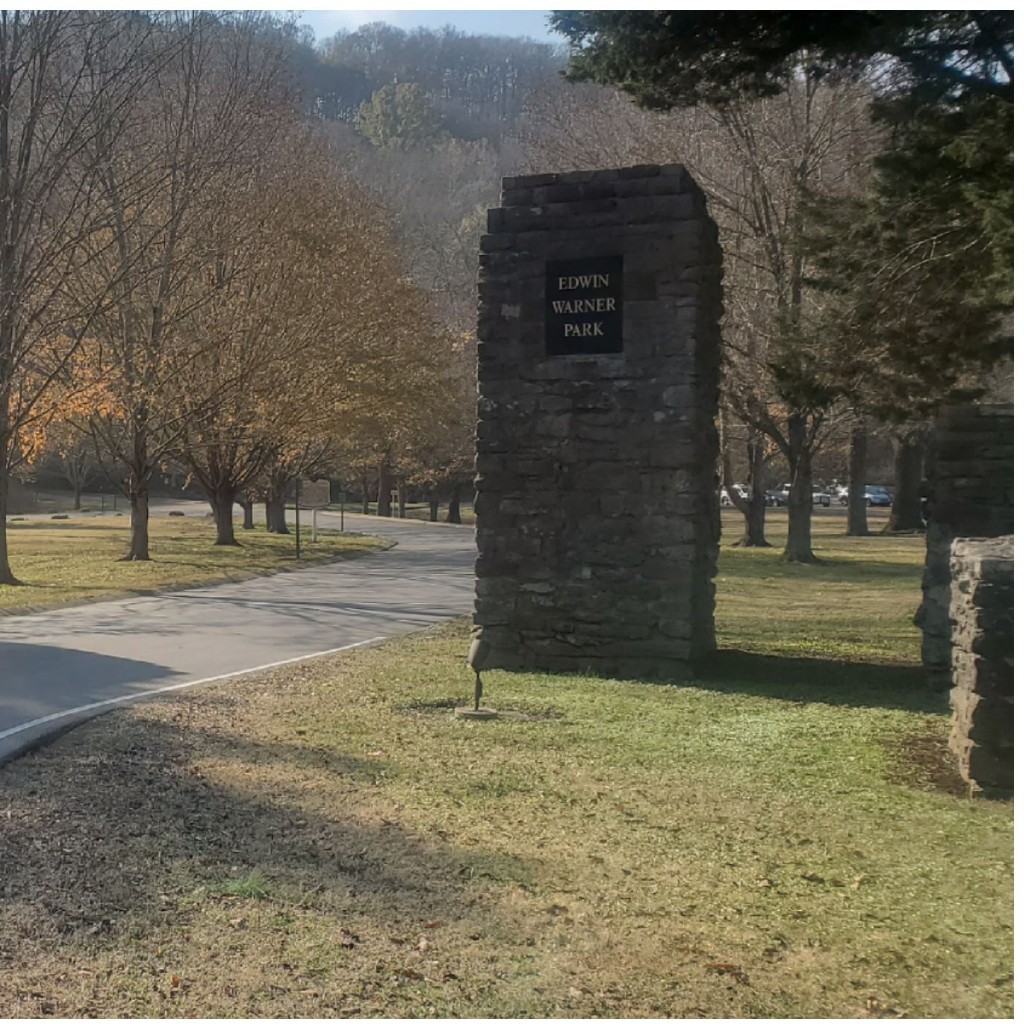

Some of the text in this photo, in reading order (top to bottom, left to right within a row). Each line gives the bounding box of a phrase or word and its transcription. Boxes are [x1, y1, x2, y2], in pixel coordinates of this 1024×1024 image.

[558, 274, 609, 290] EDWIN
[552, 297, 616, 314] WARNER
[564, 322, 604, 337] PARK
